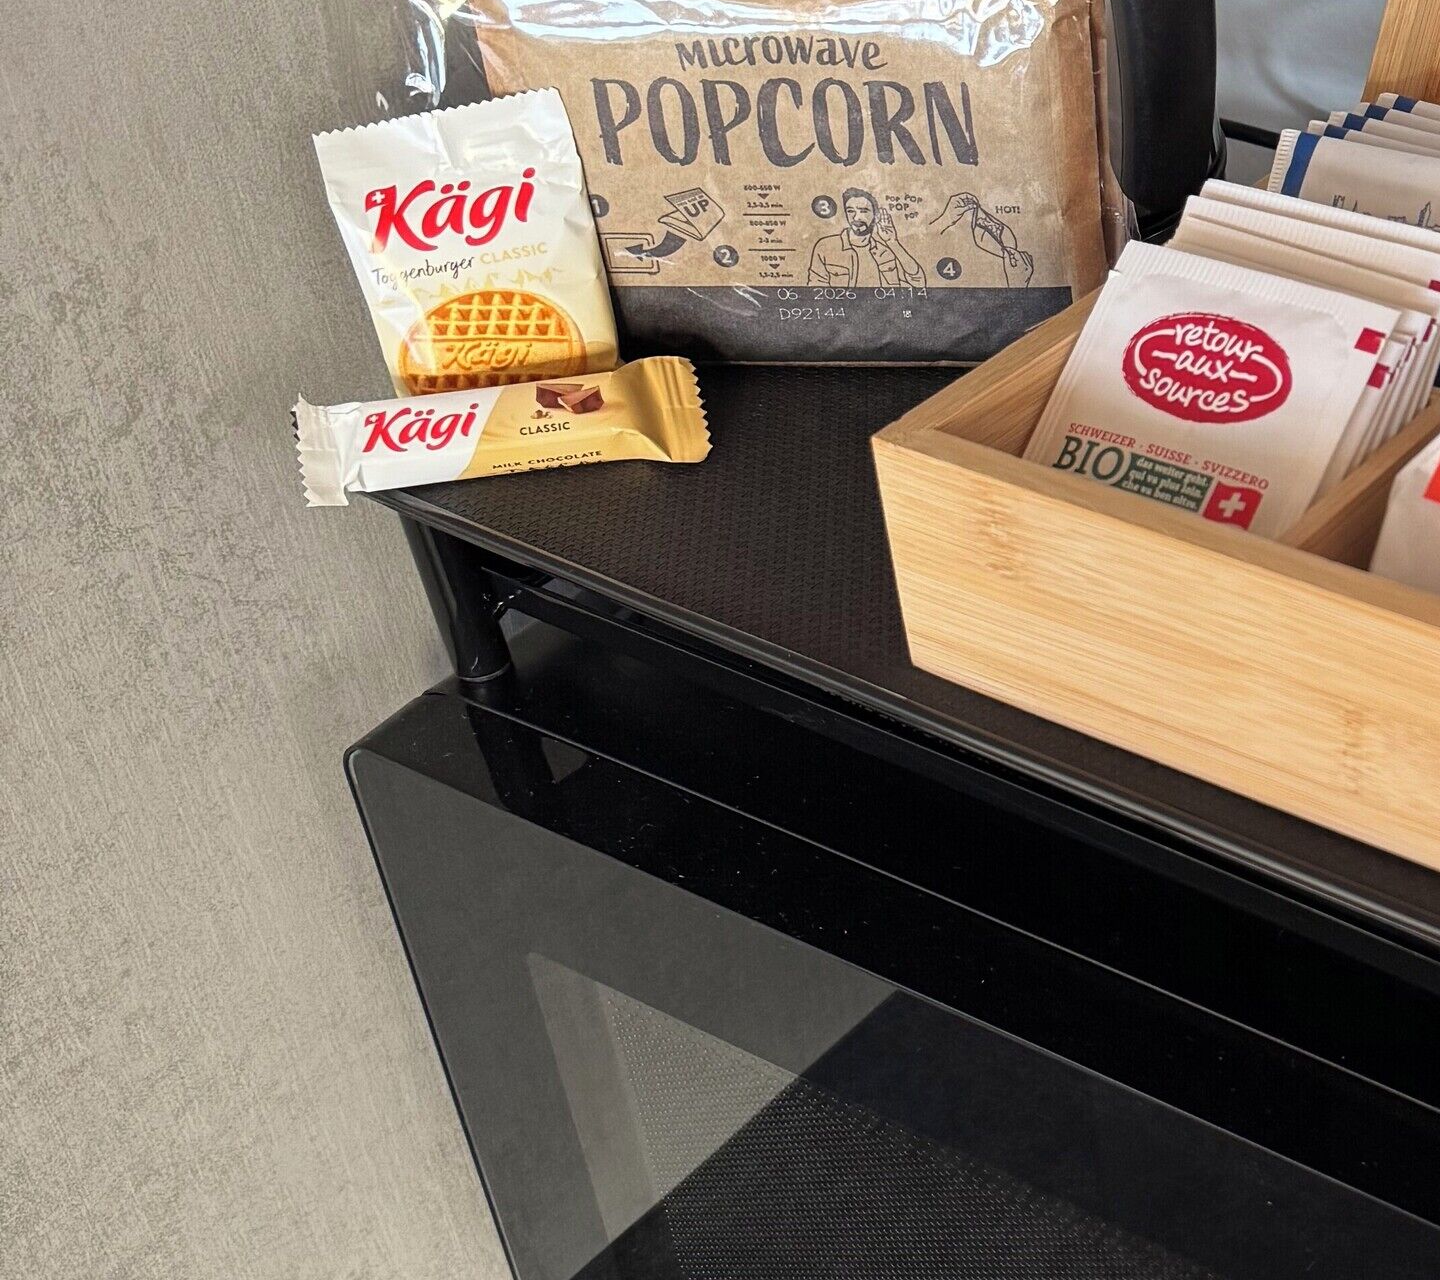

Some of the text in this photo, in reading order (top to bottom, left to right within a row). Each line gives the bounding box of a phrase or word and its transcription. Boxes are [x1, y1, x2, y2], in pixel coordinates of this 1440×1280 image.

[590, 76, 978, 167] POPCORN
[364, 167, 536, 254] Kägi
[683, 199, 709, 217] UP
[818, 200, 831, 214] 3
[995, 206, 1021, 214] HOT!
[480, 242, 548, 265] CLASSIC
[718, 249, 732, 263] 2
[942, 261, 955, 275] 4
[813, 288, 857, 300] 2026
[779, 307, 845, 320] D92144
[1174, 321, 1264, 363] retour
[1139, 368, 1250, 413] sources
[362, 402, 479, 453] Kägi
[519, 421, 571, 436] CLASSIC
[492, 461, 522, 469] MILK
[527, 450, 603, 464] CHOCOLATE
[1052, 435, 1125, 481] BIO
[1068, 422, 1269, 490] SCHWEIZER SUISSE SVIZZERO
